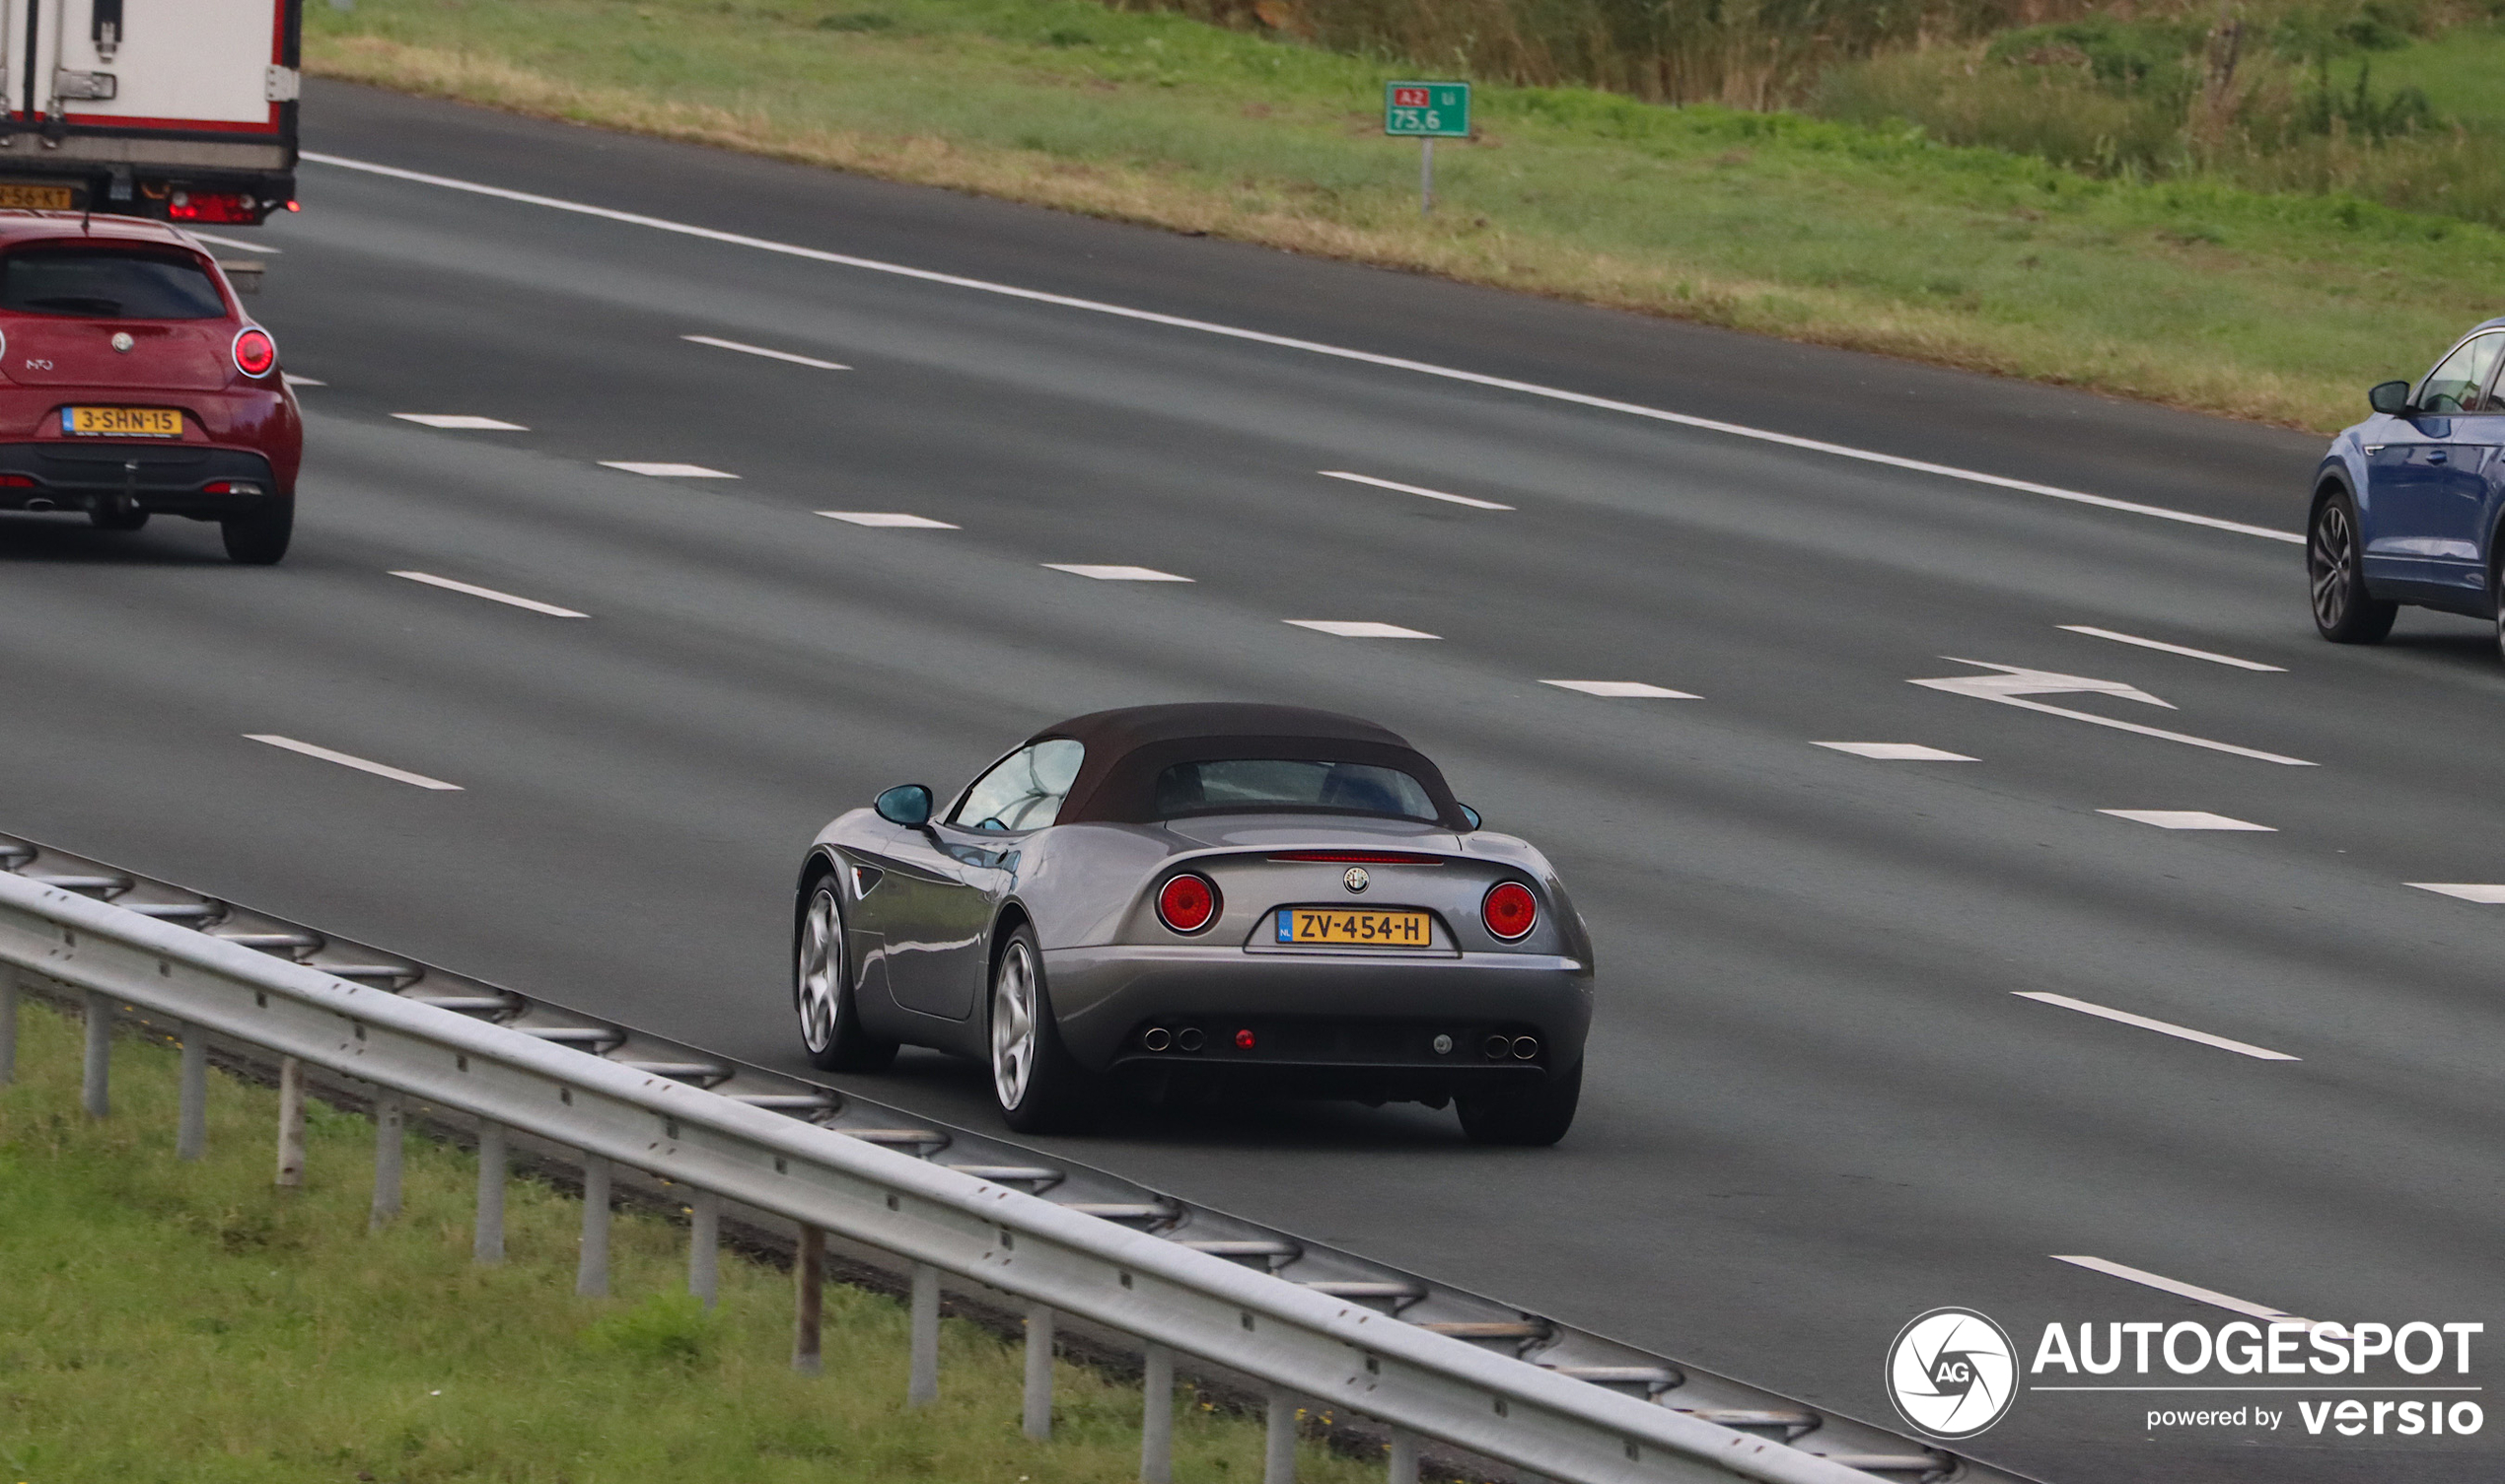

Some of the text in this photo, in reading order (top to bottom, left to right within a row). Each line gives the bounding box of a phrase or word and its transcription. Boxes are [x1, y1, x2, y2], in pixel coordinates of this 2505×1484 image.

[1400, 91, 1424, 105] A2
[82, 410, 173, 430] 3-SHN-15
[1301, 914, 1419, 940] ZV-454-H
